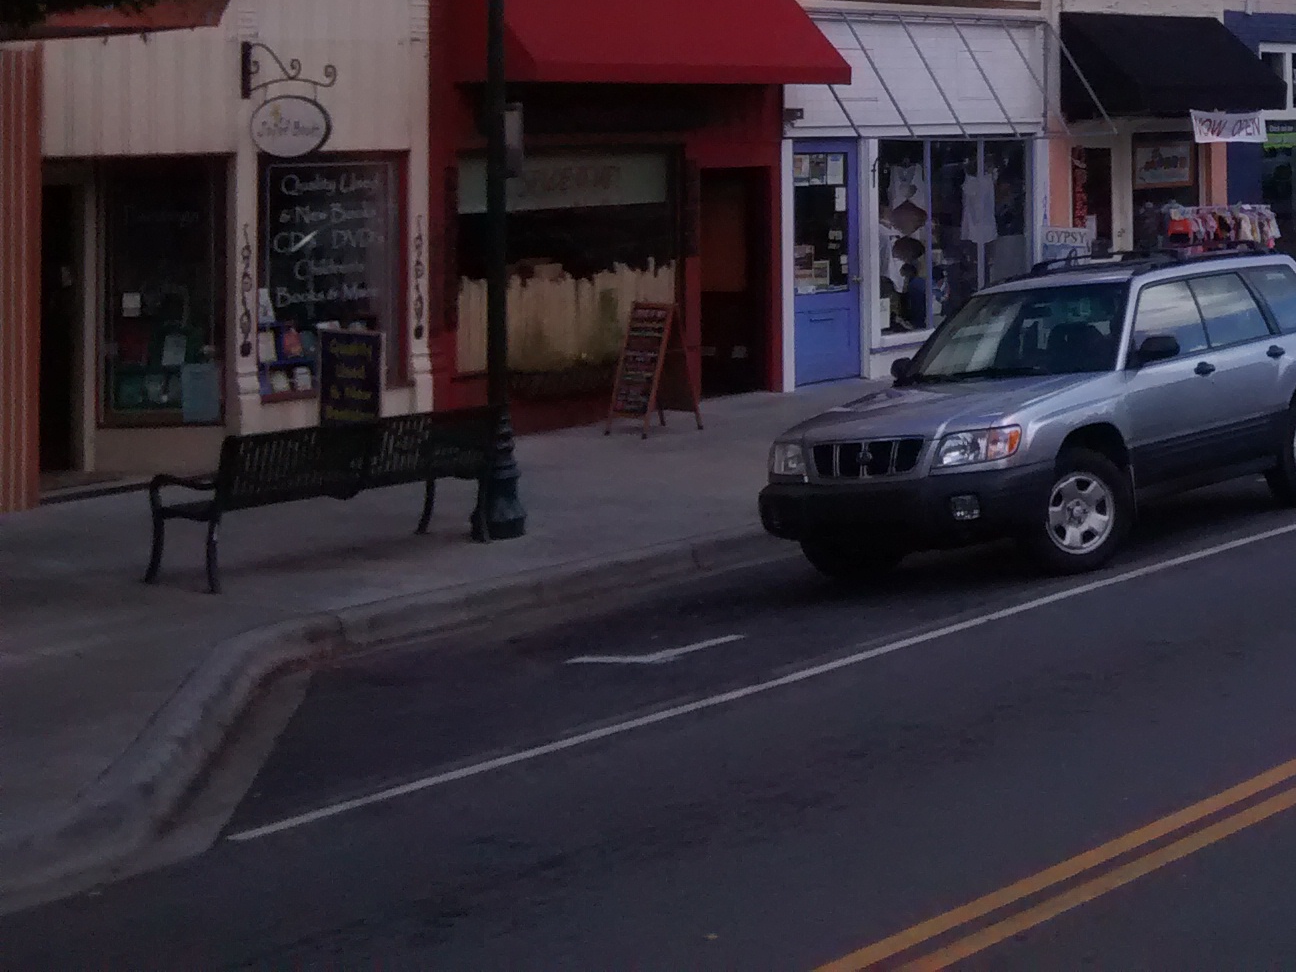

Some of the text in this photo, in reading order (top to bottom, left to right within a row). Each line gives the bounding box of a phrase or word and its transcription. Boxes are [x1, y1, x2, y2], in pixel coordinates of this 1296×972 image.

[1194, 116, 1260, 136] NOW OPEN
[281, 174, 336, 196] Quality
[295, 206, 327, 224] New
[1046, 230, 1086, 243] GYPSY
